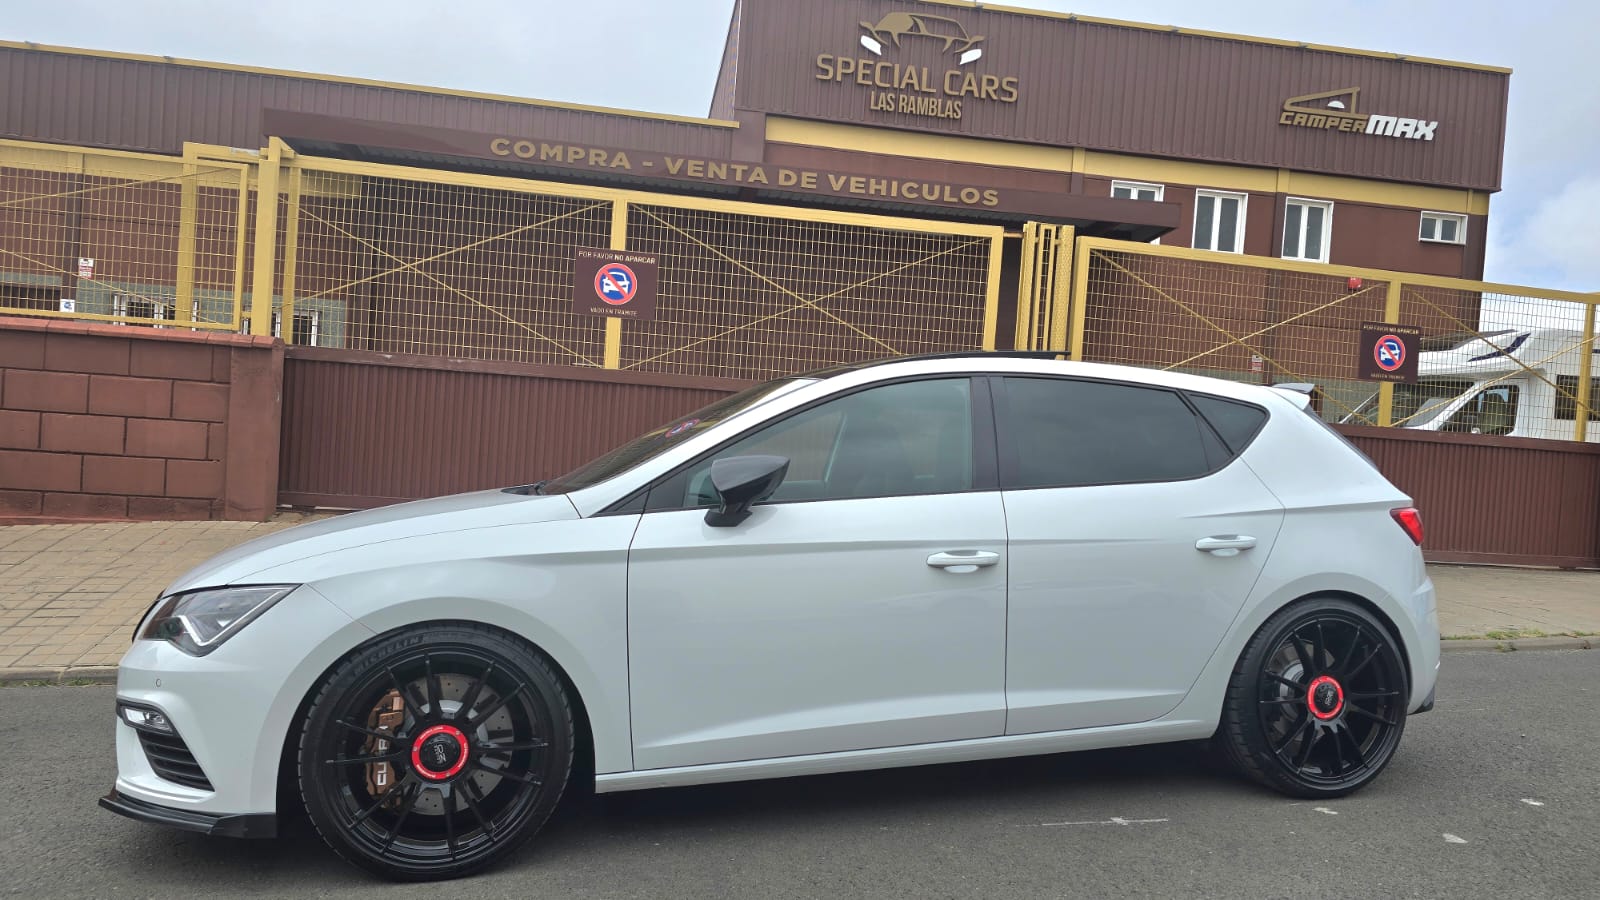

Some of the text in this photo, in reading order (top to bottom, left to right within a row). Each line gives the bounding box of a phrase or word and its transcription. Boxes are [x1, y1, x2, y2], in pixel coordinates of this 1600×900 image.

[815, 53, 1018, 103] SPECIAL CARS
[870, 91, 962, 119] LAS RAMBLAS
[490, 138, 632, 170] COMPRA
[664, 156, 768, 185] VENTA
[778, 168, 818, 190] DE
[828, 173, 999, 207] VEHICULOS
[593, 252, 613, 260] FAVOR
[625, 255, 656, 264] APARCAR
